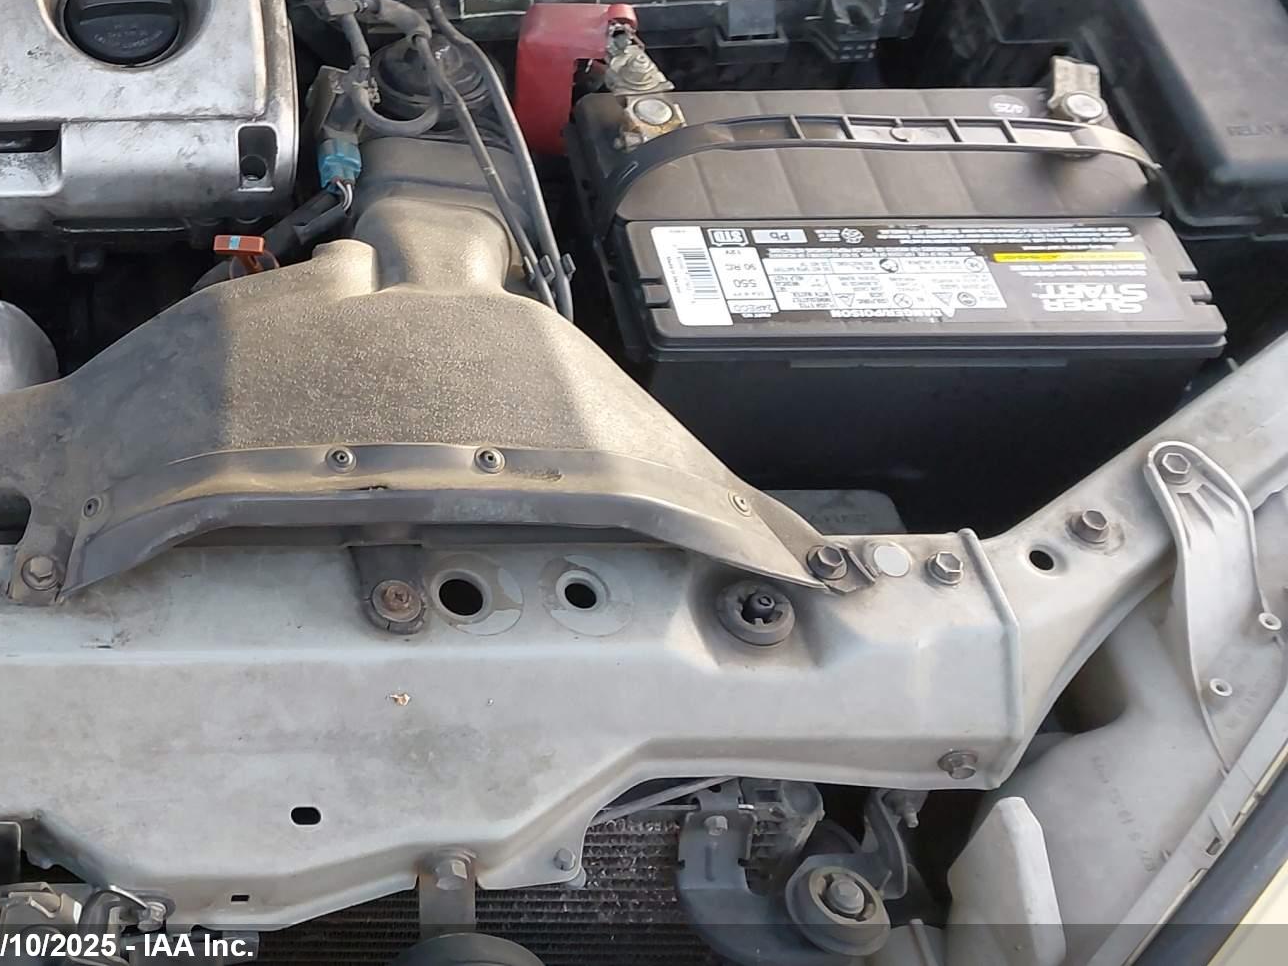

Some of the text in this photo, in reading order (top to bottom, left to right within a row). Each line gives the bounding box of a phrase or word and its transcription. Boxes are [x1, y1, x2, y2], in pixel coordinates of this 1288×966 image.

[992, 102, 1024, 113] 4/25
[768, 230, 790, 242] Pb
[732, 278, 757, 288] 550
[1038, 282, 1148, 302] START
[1042, 298, 1144, 314] SUPER
